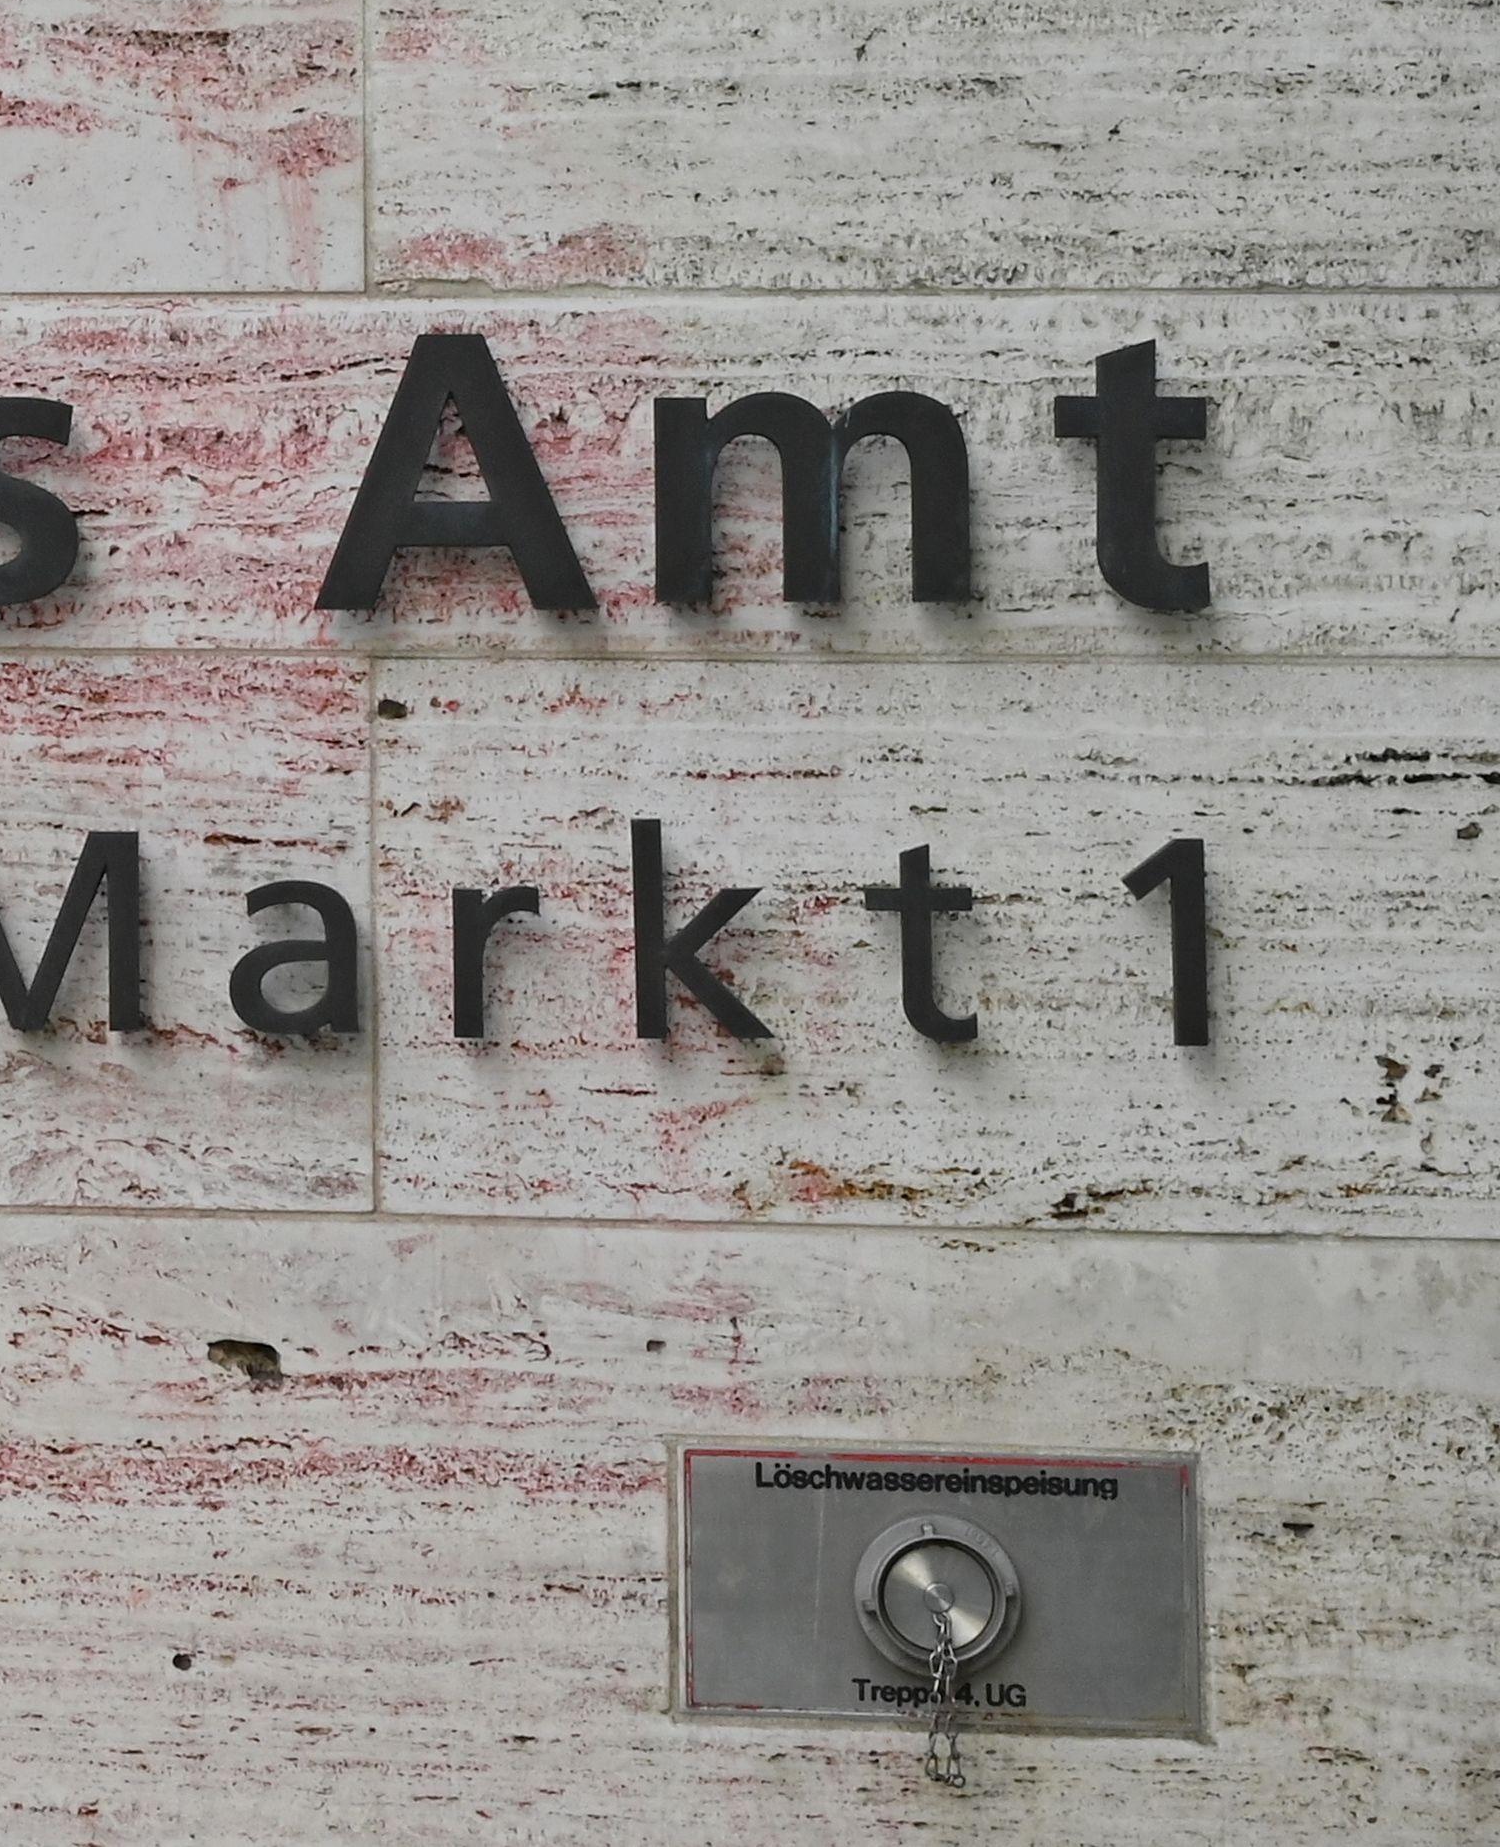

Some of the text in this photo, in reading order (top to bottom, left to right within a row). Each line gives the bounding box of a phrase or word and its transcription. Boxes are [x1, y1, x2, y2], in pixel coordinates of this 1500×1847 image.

[313, 333, 1211, 612] Amt
[1121, 837, 1209, 1047] 1
[755, 1461, 1119, 1501] Löschwassereinspeisung
[986, 1683, 1027, 1708] UG
